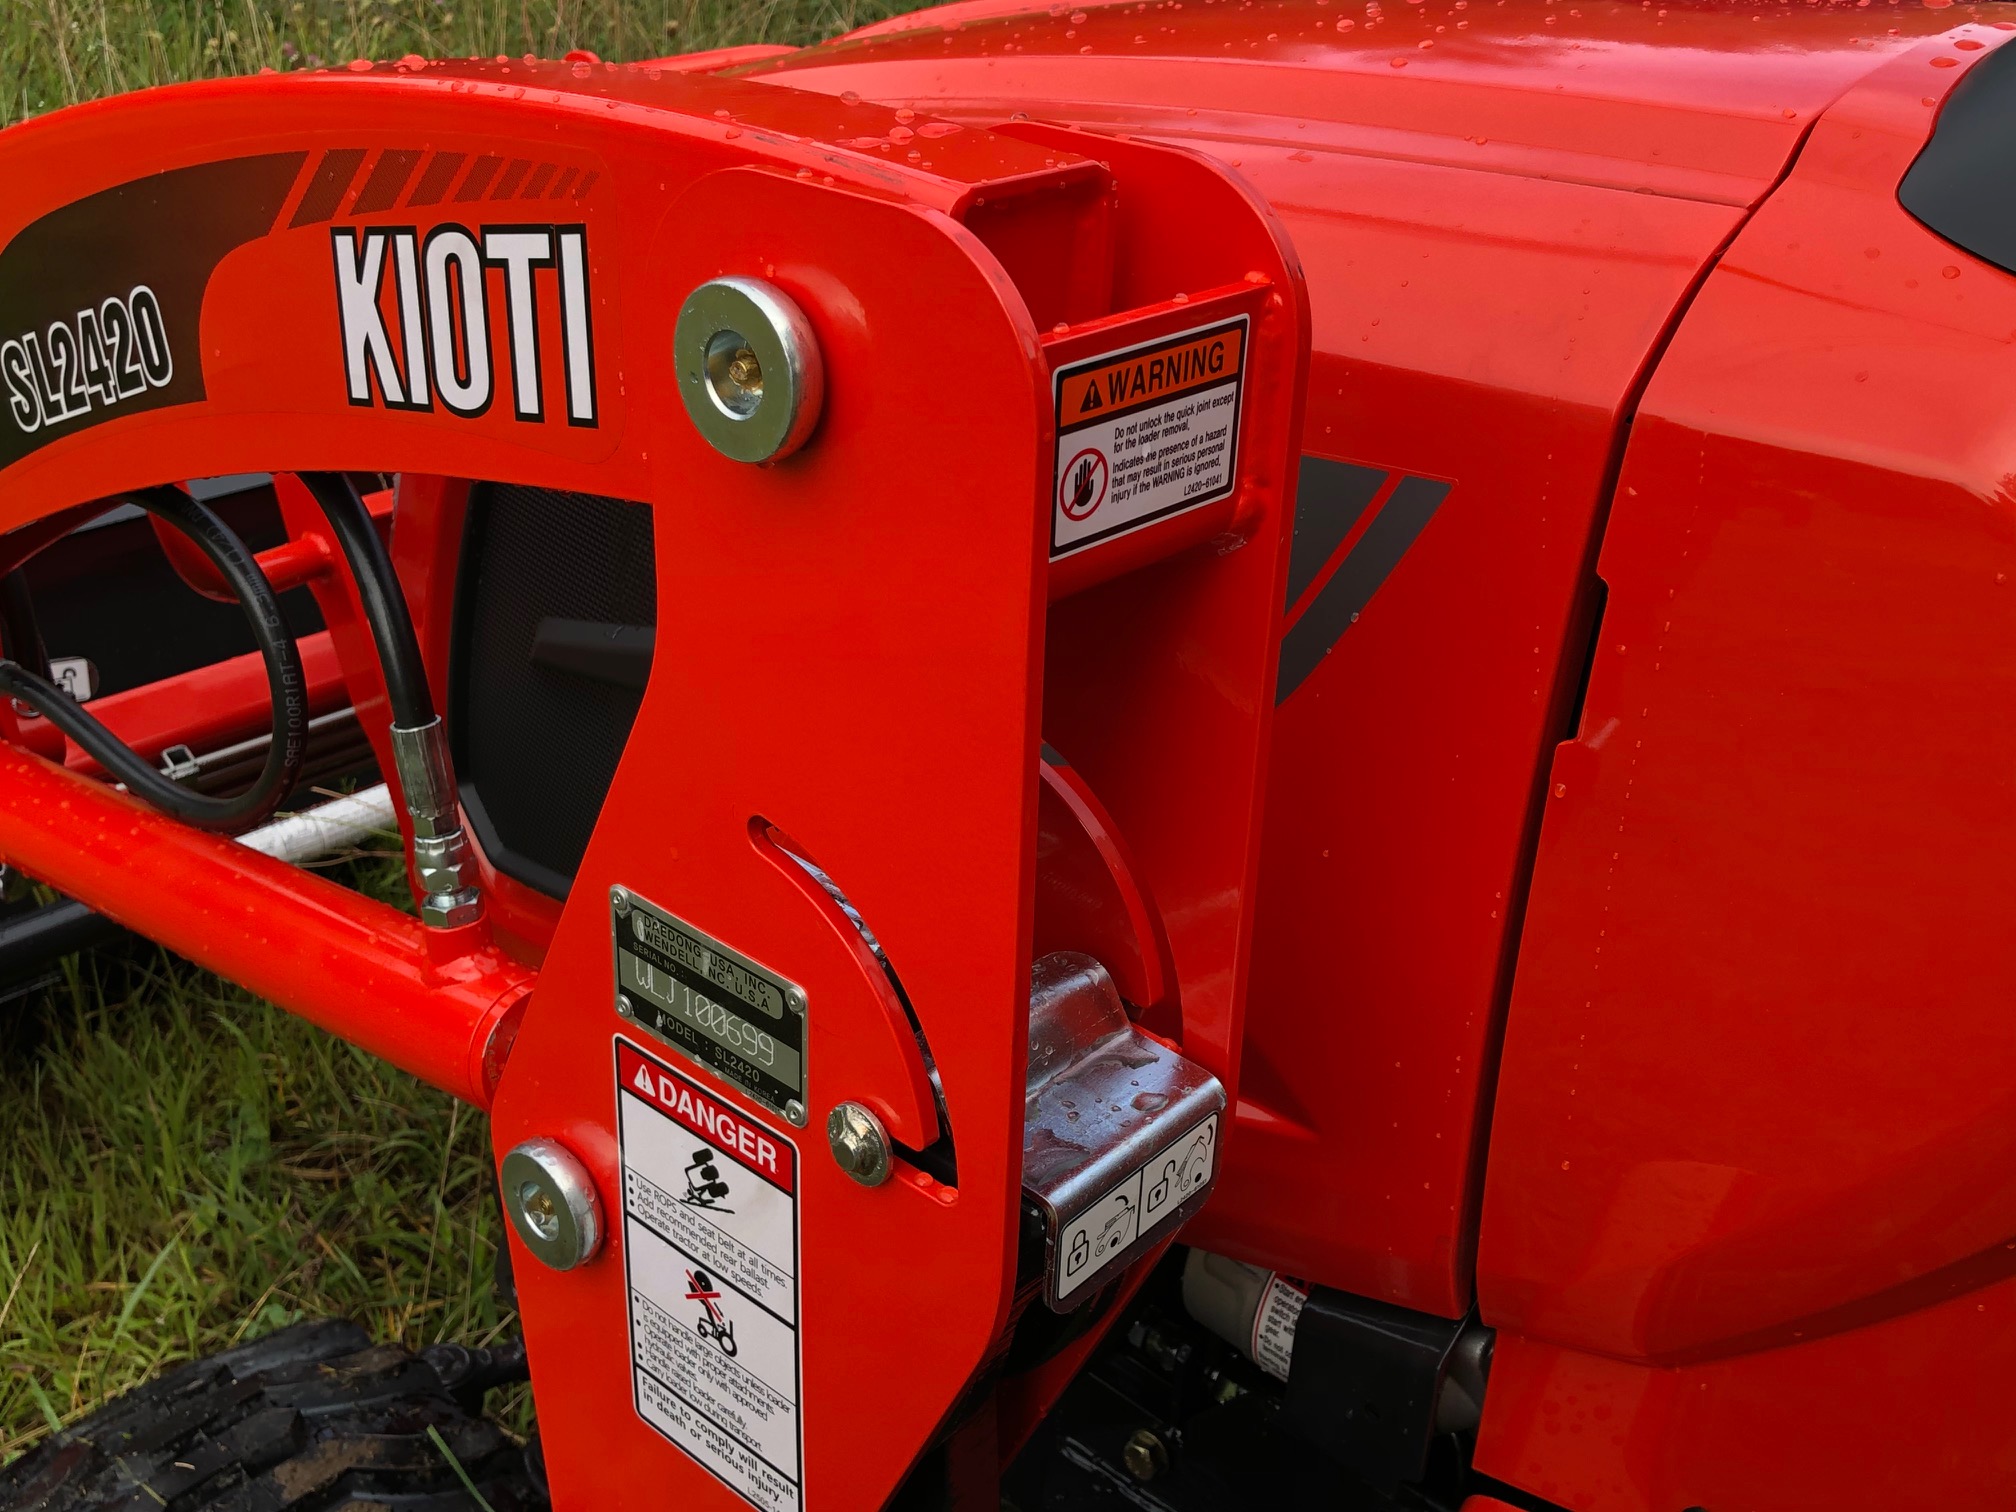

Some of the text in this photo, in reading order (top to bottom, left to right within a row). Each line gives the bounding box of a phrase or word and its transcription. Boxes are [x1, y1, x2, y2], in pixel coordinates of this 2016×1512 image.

[0, 285, 173, 433] SL2420
[331, 222, 599, 429] KIOTI
[1108, 341, 1224, 405] WARNING
[1112, 456, 1144, 474] Indicates
[1146, 451, 1156, 462] the
[1158, 442, 1189, 460] presence
[1191, 434, 1198, 446] of
[1205, 424, 1227, 442] hazard
[1114, 391, 1234, 440] Do not unlock the quick joint except
[1114, 442, 1123, 454] for
[1125, 438, 1136, 450] the
[1138, 430, 1160, 445] loader
[1111, 487, 1131, 504] injury
[1132, 484, 1138, 495] if
[1140, 480, 1150, 493] the
[1152, 467, 1185, 489] WARNING
[1186, 466, 1192, 477] is
[1112, 439, 1226, 489] that may result in serious personal
[633, 942, 662, 965] SERIAL
[708, 966, 729, 989] NC.
[735, 982, 770, 1011] U.S.A
[744, 973, 770, 999] INC.
[635, 956, 774, 1066] WLJ100699
[659, 1011, 698, 1045] MODEL
[715, 1046, 760, 1082] SL2420
[659, 1075, 778, 1174] DANGER
[636, 1178, 788, 1289] Use ROPS and seat belt at all times.
[637, 1192, 770, 1290] Add recommended rear ballast.
[637, 1204, 764, 1298] Operate tractor at low speeds.
[642, 1300, 790, 1414] Do not handle large objects unless loader
[644, 1324, 768, 1422] Operate loader only with approved
[646, 1346, 670, 1372] Handle
[671, 1368, 691, 1388] raised
[693, 1382, 716, 1405] loader
[650, 1320, 683, 1348] equipped
[685, 1344, 701, 1361] with
[702, 1358, 727, 1379] proper
[646, 1359, 664, 1379] Carry
[666, 1372, 687, 1394] loader
[689, 1389, 703, 1407] low
[704, 1402, 728, 1428] during
[642, 1376, 794, 1500] Failure to comply will result
[643, 1389, 783, 1504] in death or serious injury.
